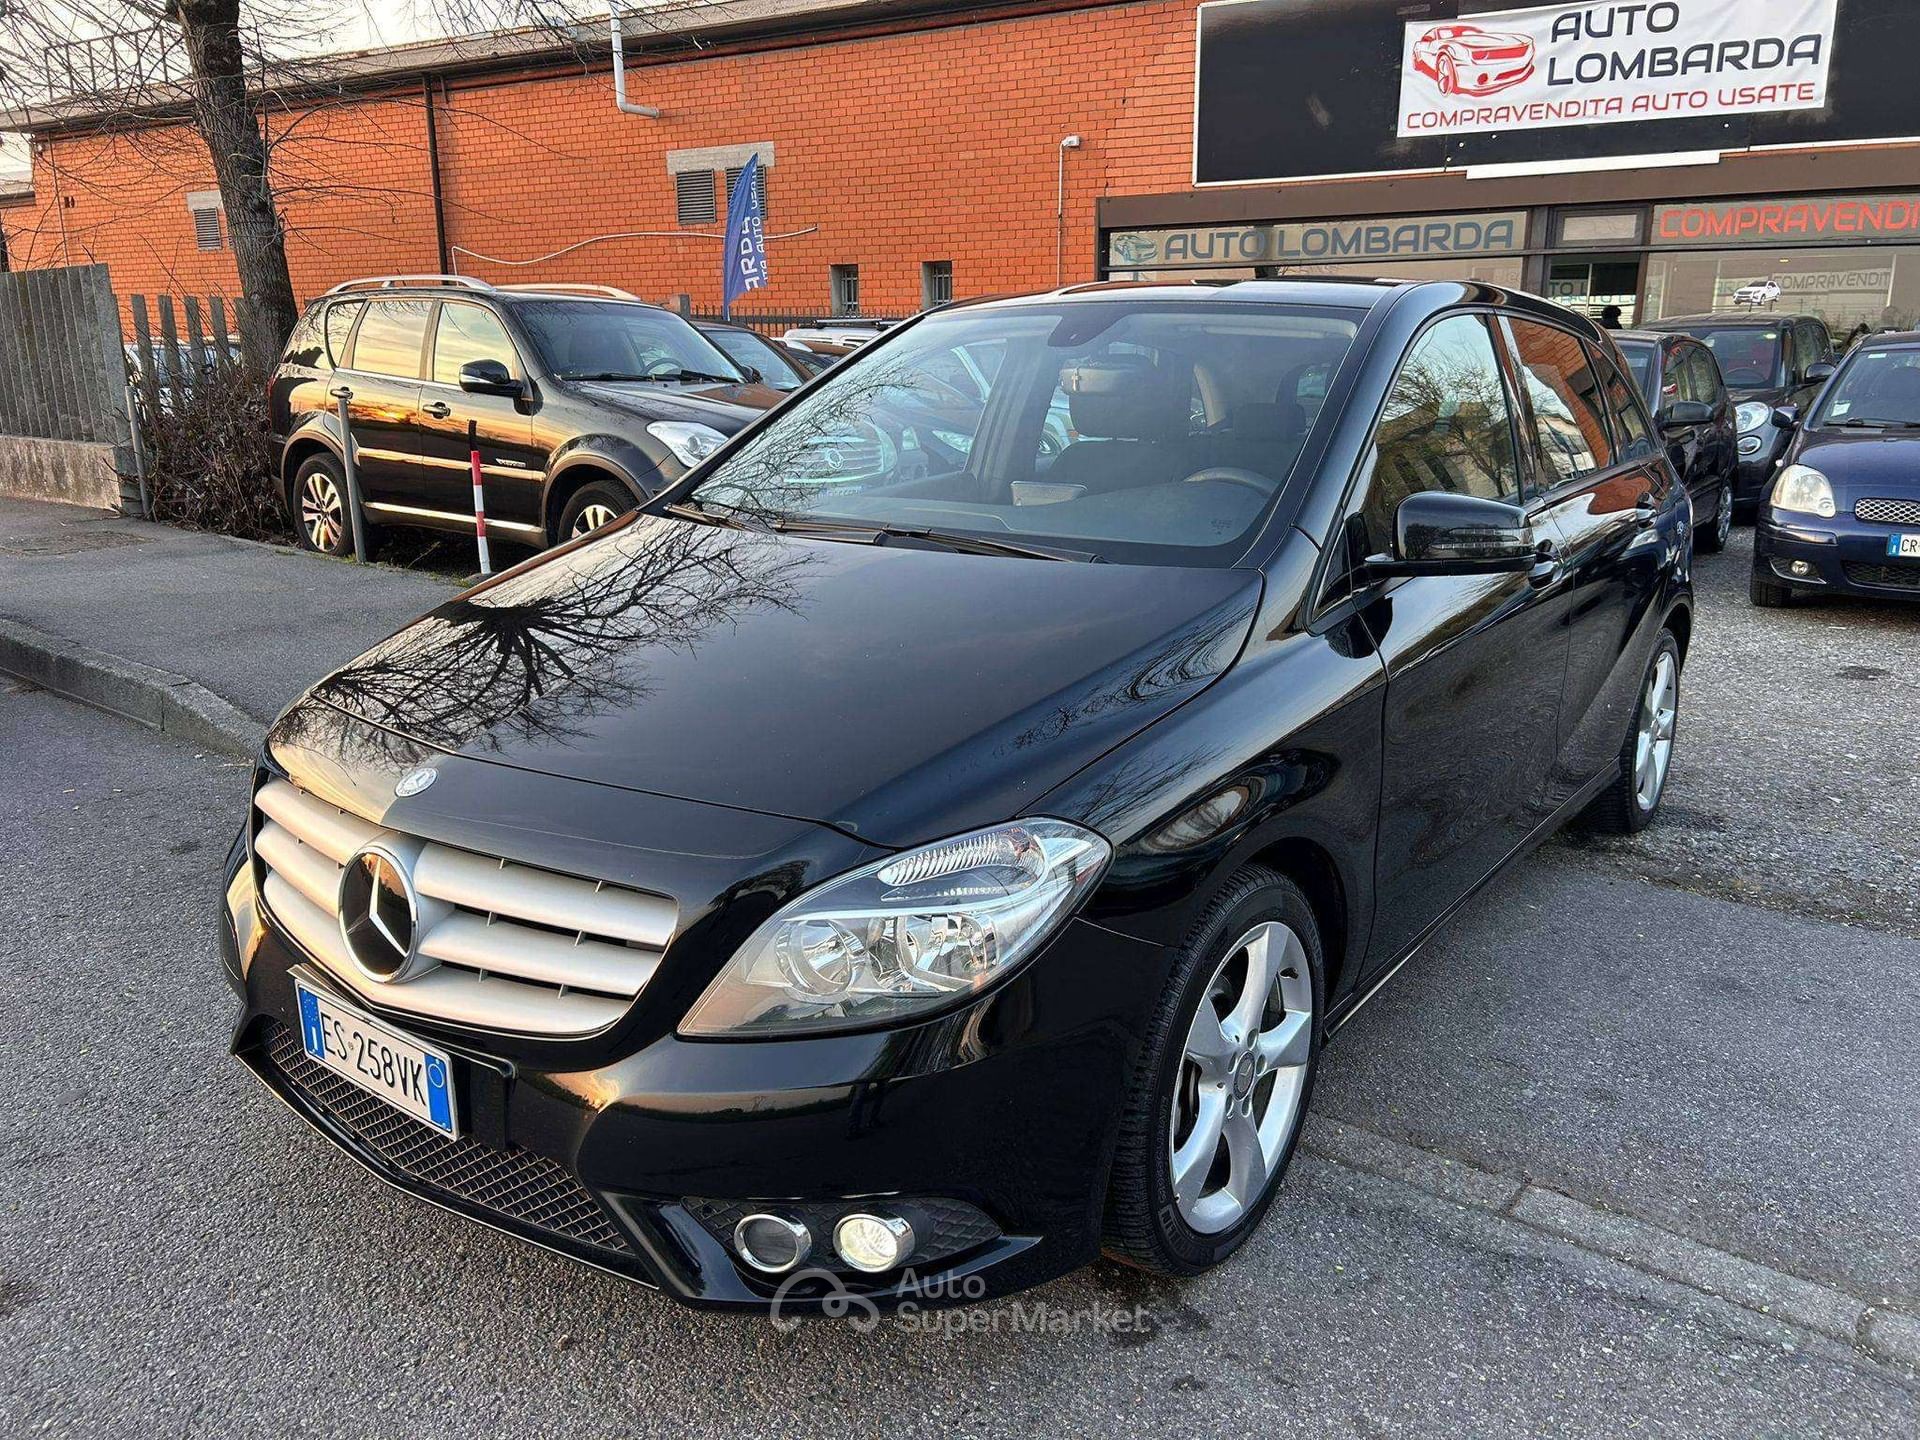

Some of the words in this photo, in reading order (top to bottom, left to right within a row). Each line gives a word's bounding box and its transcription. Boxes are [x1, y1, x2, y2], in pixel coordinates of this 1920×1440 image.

[1551, 2, 1680, 43] AUTO
[1547, 34, 1822, 86] LOMBARDA
[1407, 98, 1622, 129] COMPRAVENDITA
[1631, 91, 1708, 113] AUTO
[1718, 82, 1815, 106] USATE
[752, 217, 764, 253] AUTO
[1165, 230, 1267, 260] AUTO
[1277, 219, 1514, 257] LOMBARDA
[1659, 200, 1919, 238] COMPRAVENDI
